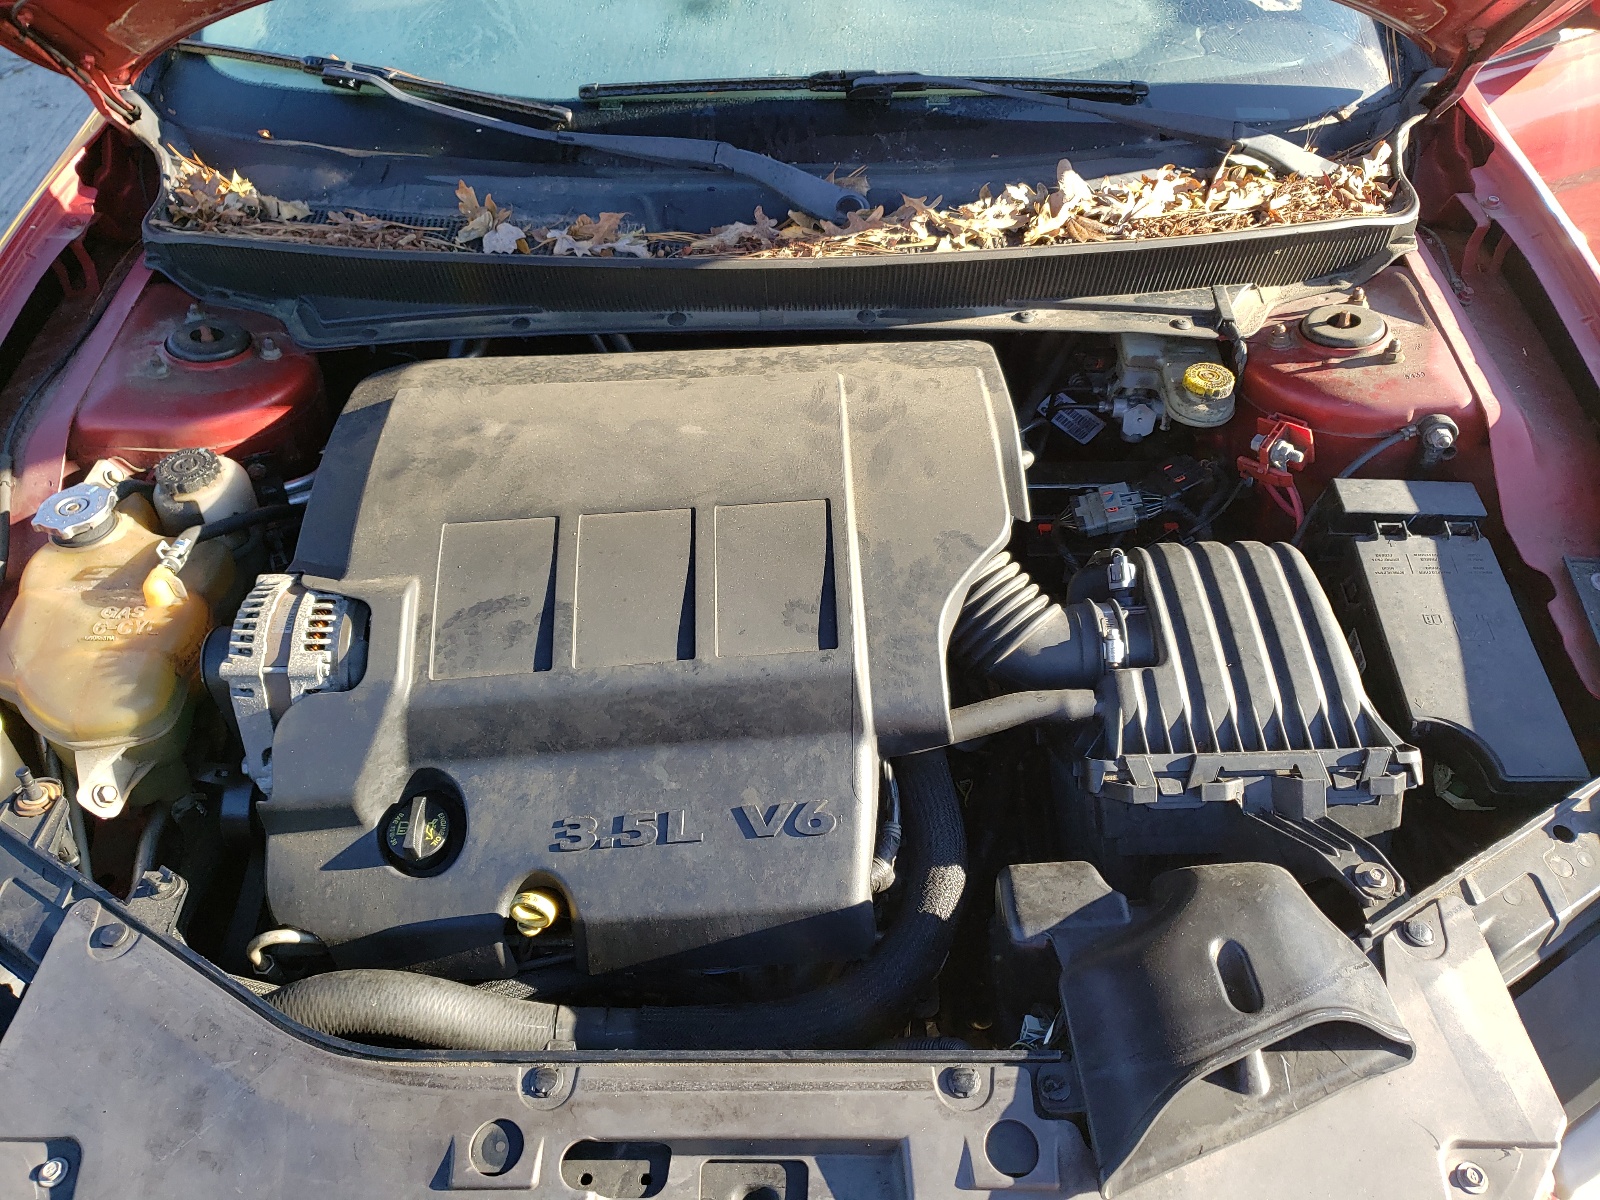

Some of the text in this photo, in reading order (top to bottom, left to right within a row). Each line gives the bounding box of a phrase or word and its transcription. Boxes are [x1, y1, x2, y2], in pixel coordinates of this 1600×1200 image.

[100, 605, 147, 620] GAS
[548, 799, 837, 853] 3.5L V6
[430, 836, 442, 846] OIL
